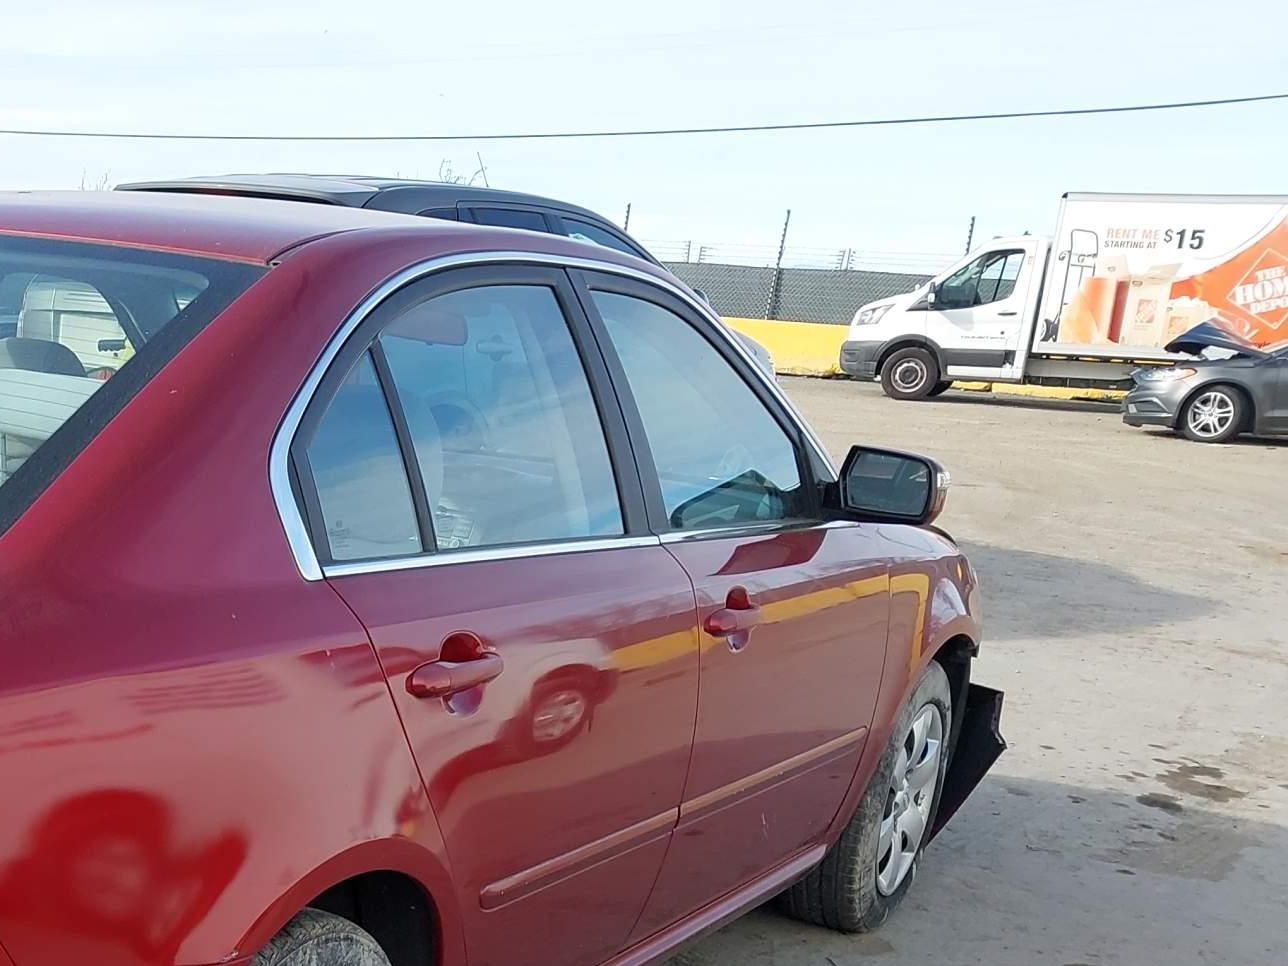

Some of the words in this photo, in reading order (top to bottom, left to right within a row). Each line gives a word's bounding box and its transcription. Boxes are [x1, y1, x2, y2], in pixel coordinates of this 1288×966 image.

[1106, 228, 1138, 239] RENT
[1142, 228, 1161, 240] ME
[1164, 228, 1206, 250] $15
[1103, 240, 1144, 249] STARTING
[1146, 241, 1158, 249] AT
[1255, 265, 1286, 282] THE
[1236, 276, 1288, 305] HOM
[1250, 296, 1288, 314] DEPO
